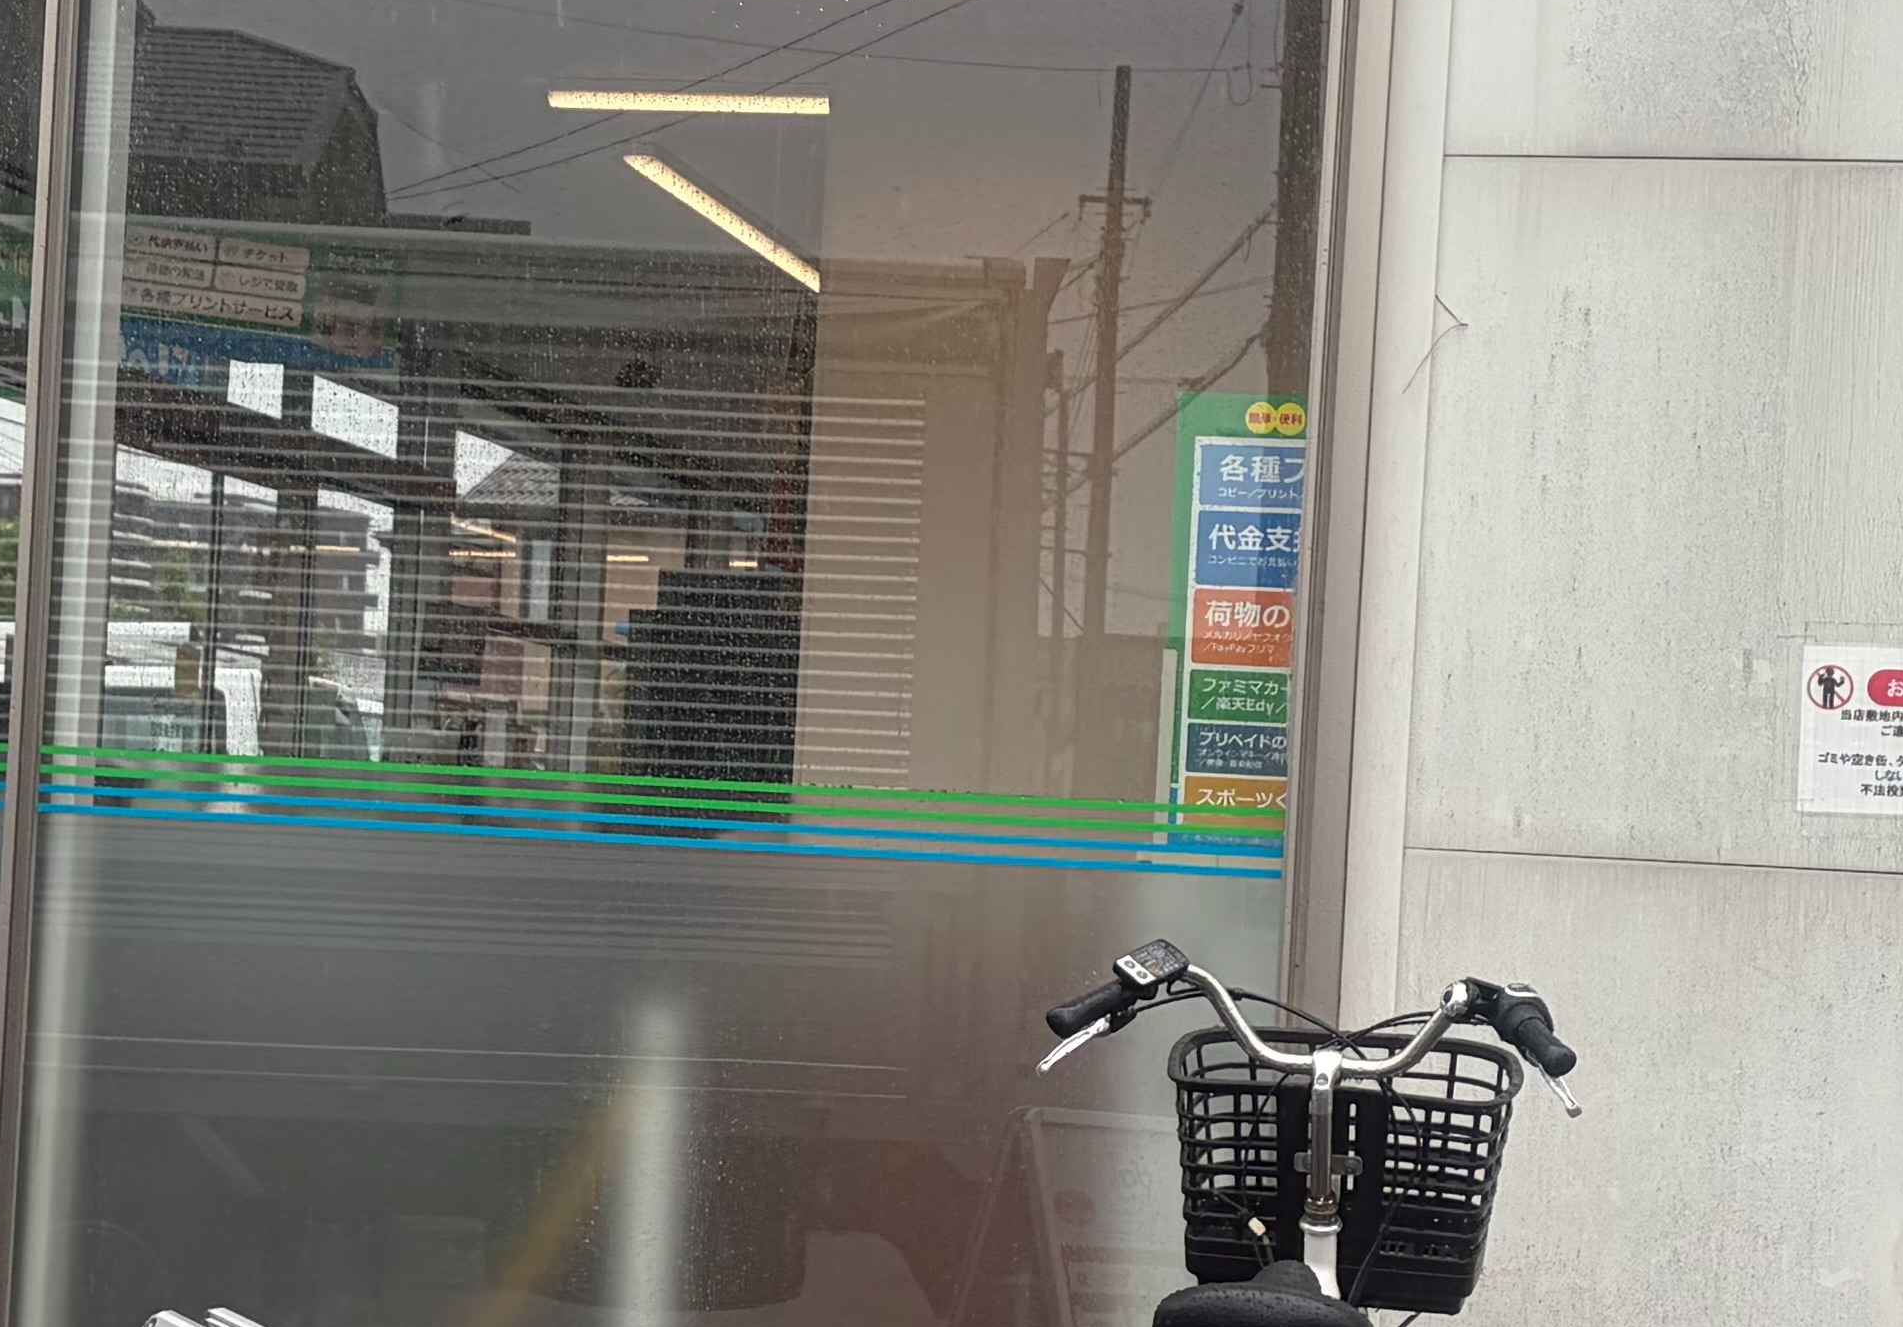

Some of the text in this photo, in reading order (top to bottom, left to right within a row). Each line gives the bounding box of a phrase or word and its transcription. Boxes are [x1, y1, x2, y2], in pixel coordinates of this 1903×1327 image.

[140, 287, 295, 322] 各種プリントサービス
[1204, 599, 1291, 628] 荷物の
[1199, 730, 1287, 750] プリペイドの
[1196, 787, 1287, 810] スポーツく
